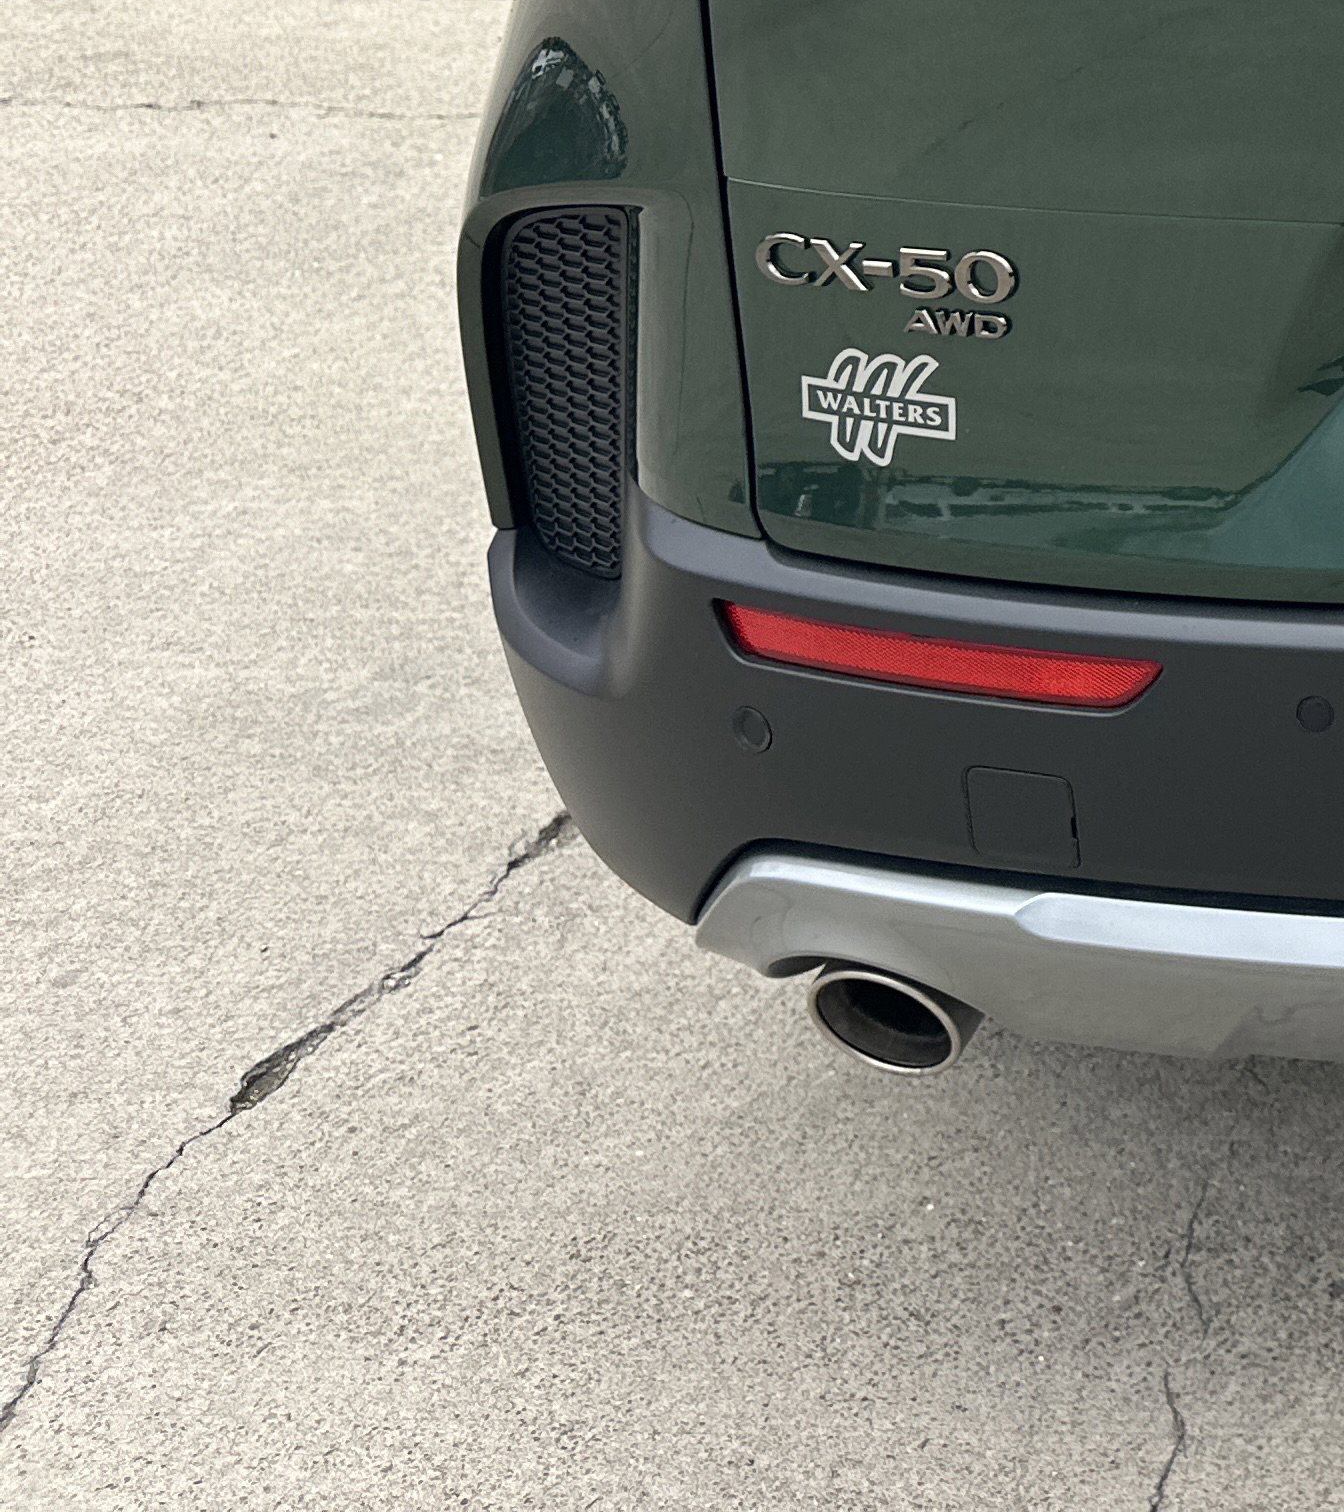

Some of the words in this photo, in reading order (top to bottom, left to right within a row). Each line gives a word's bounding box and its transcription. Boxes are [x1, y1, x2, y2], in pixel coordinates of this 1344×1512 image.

[755, 231, 1017, 304] CX-50
[903, 308, 1009, 339] AWD
[816, 389, 942, 427] WALTERS
